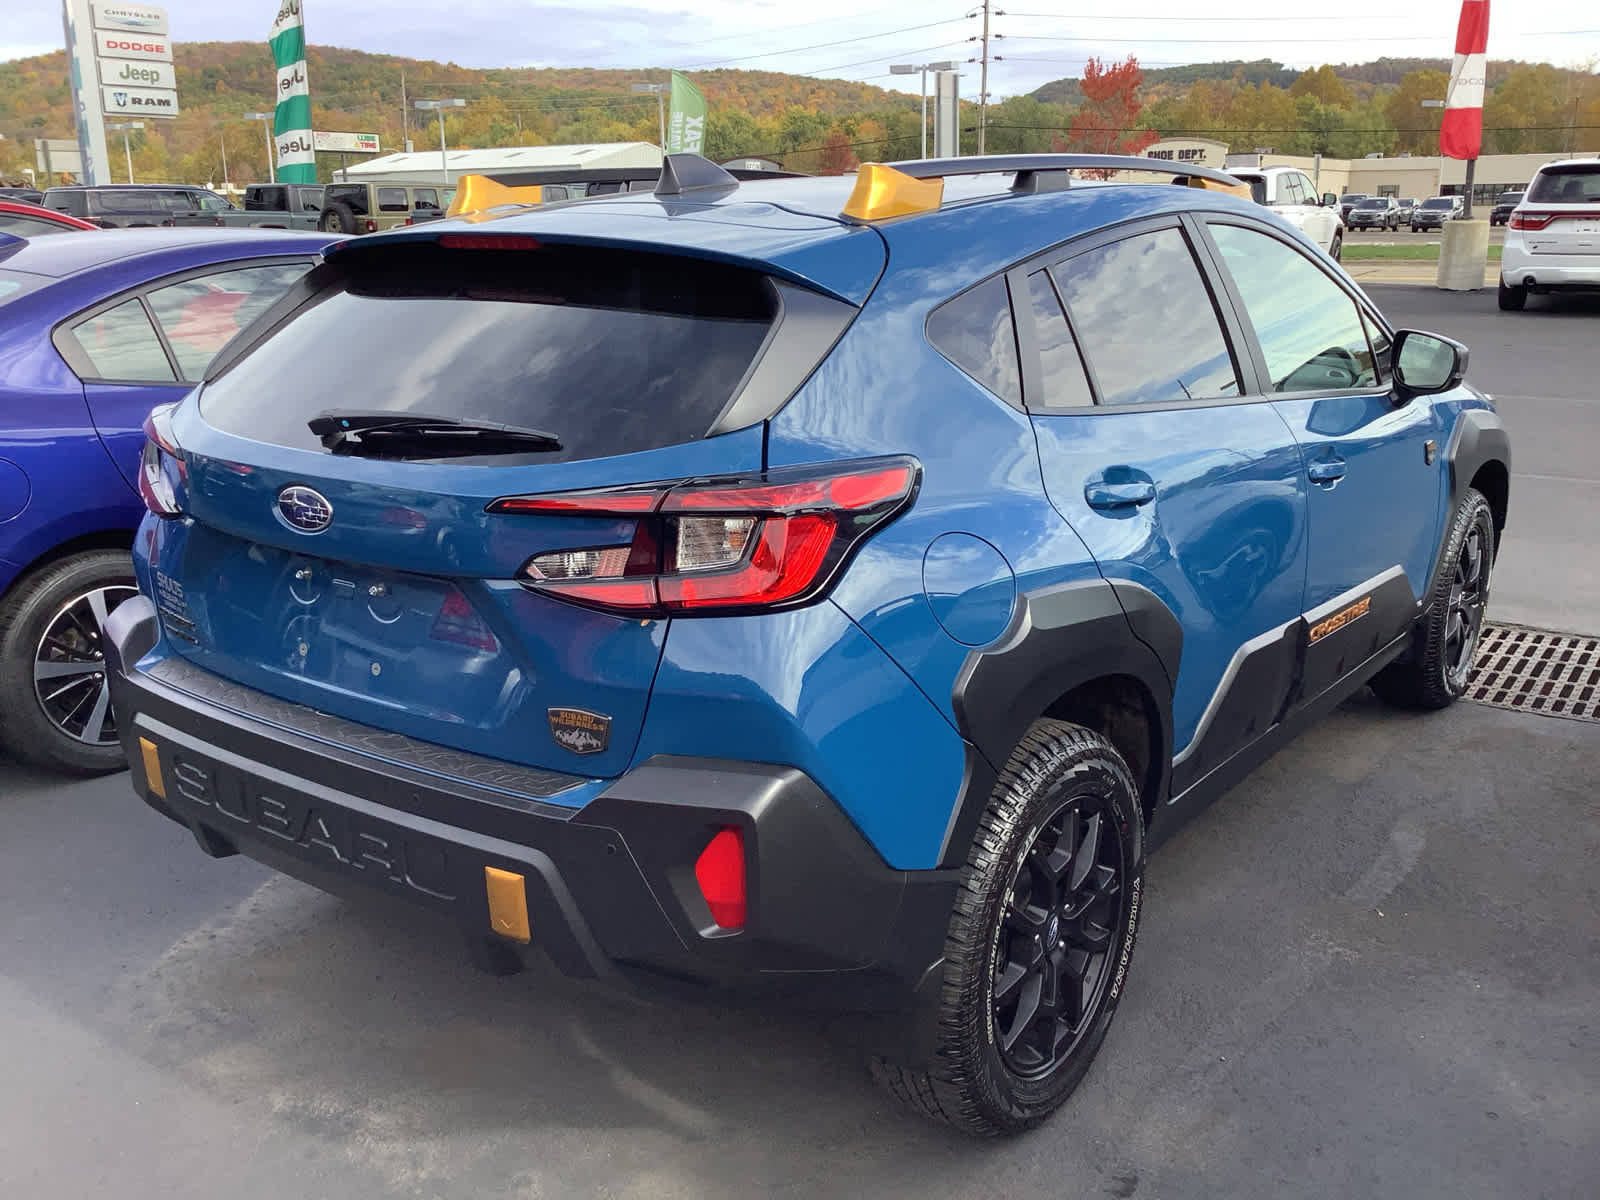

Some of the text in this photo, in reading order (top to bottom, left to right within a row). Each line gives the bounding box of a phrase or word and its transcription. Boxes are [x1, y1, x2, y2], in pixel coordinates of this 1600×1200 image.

[104, 9, 160, 20] CHRYSLER
[106, 40, 166, 53] DODGE
[119, 63, 160, 85] Jeep
[131, 97, 172, 107] RAM
[1178, 149, 1207, 160] DEPT.
[174, 761, 457, 901] SUBARU
